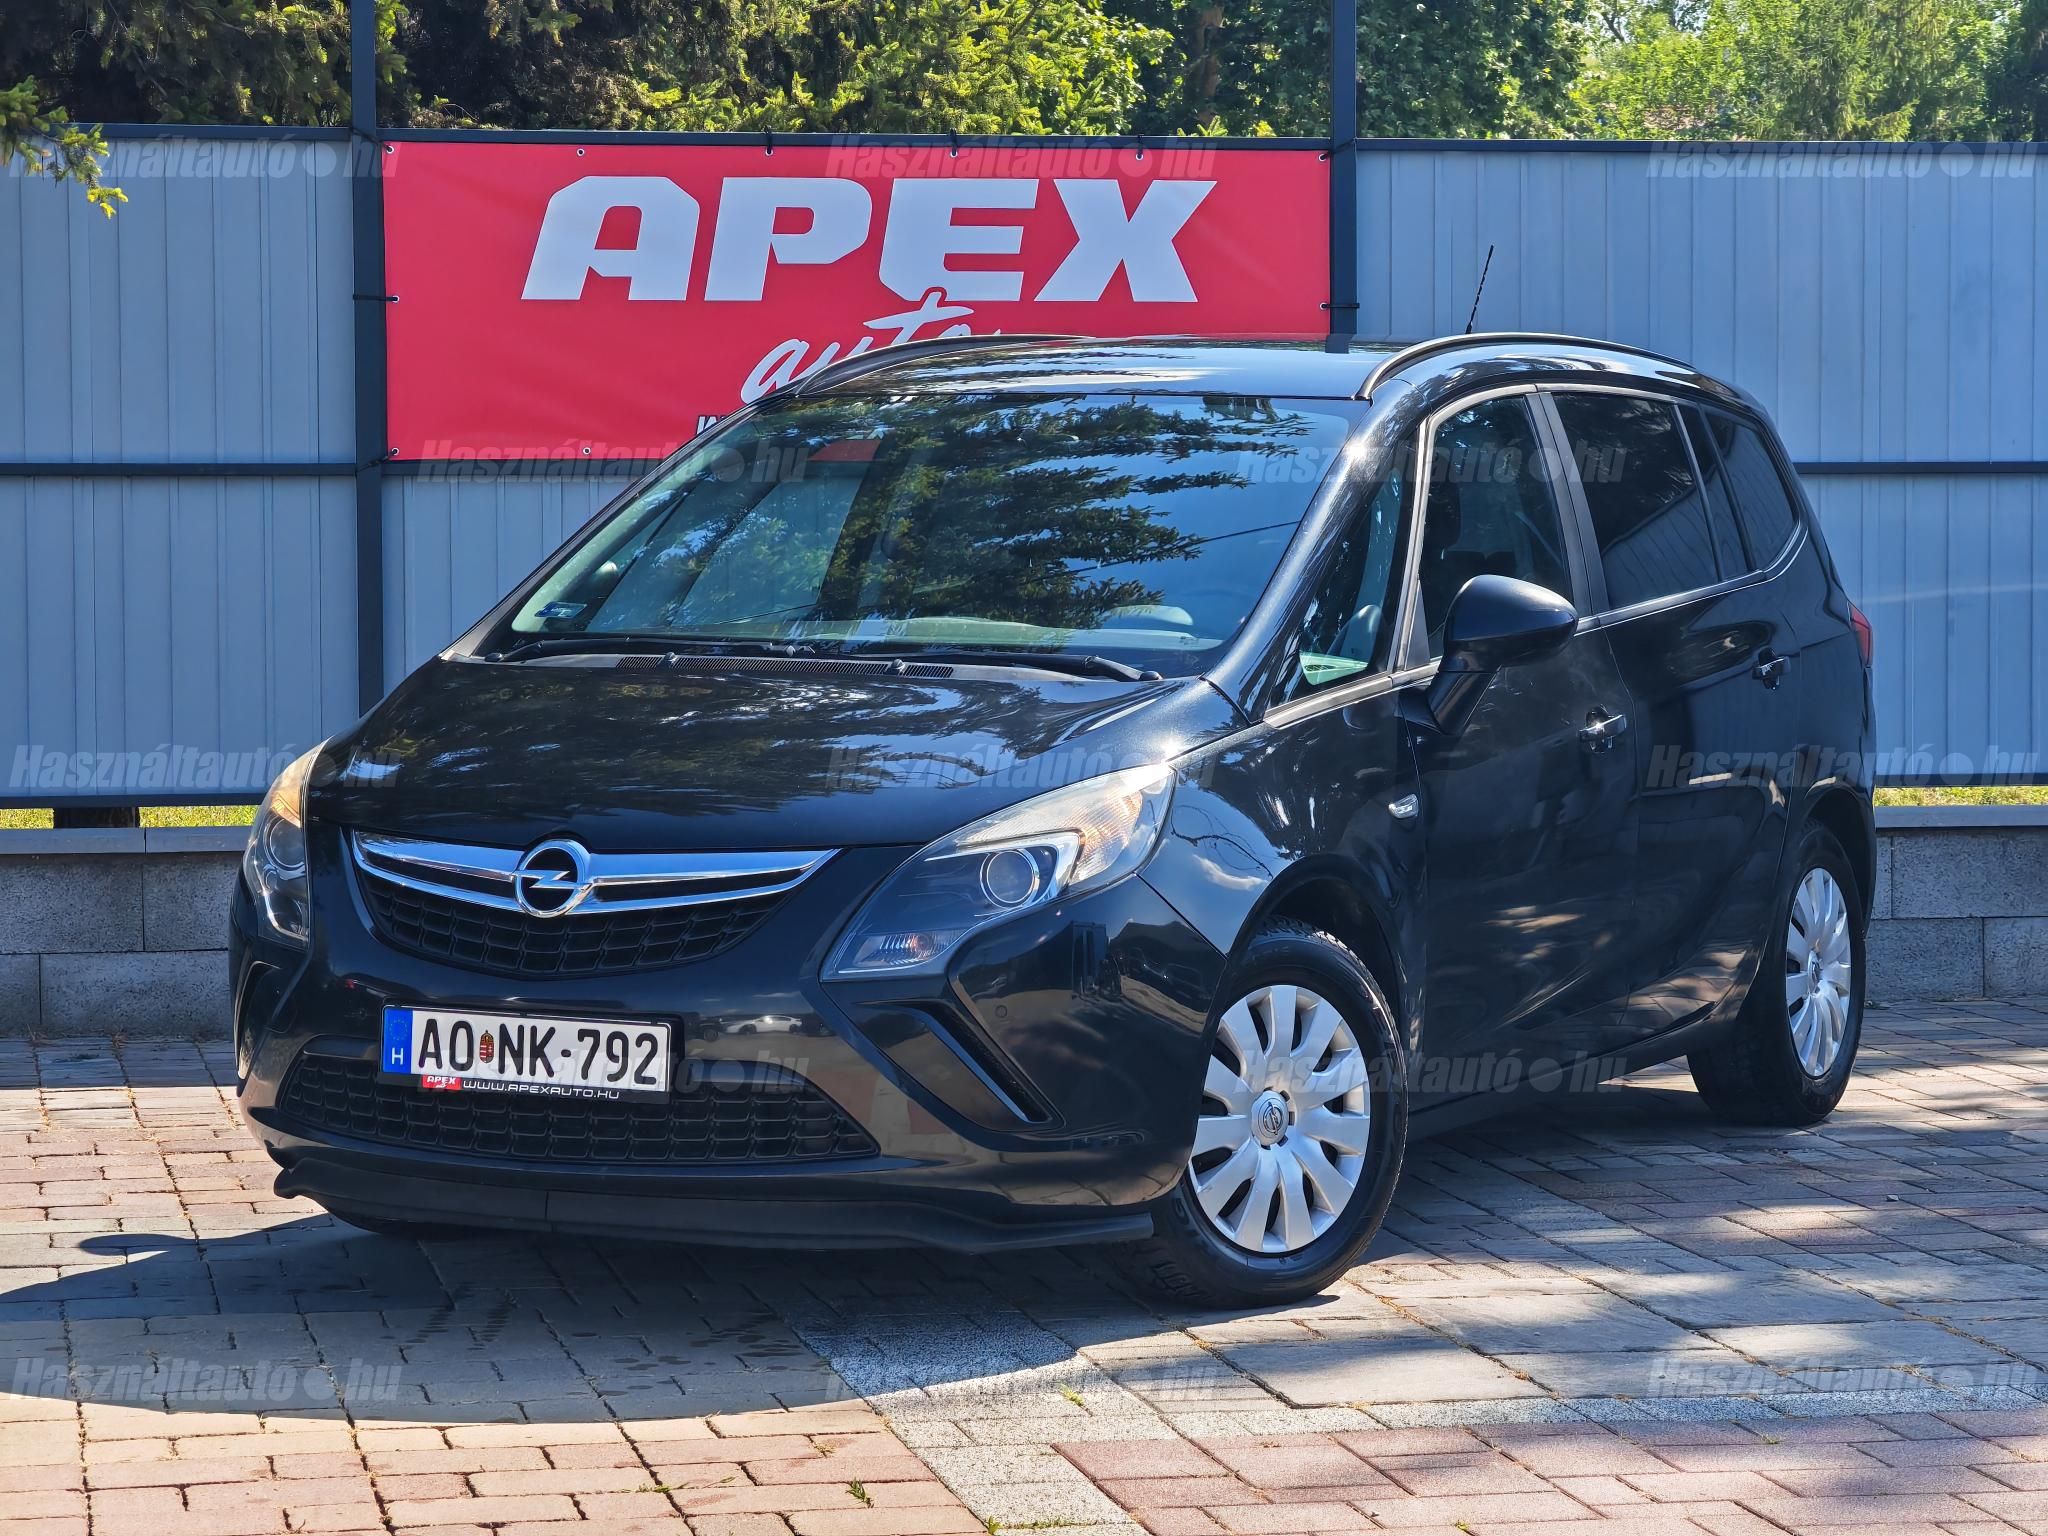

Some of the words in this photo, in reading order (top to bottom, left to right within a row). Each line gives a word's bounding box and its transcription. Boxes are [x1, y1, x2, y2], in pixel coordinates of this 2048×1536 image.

[520, 175, 1217, 302] APEX
[391, 1047, 404, 1065] H
[426, 1075, 456, 1085] APEX
[463, 1079, 620, 1099] WWW.APEXAUTO.HU
